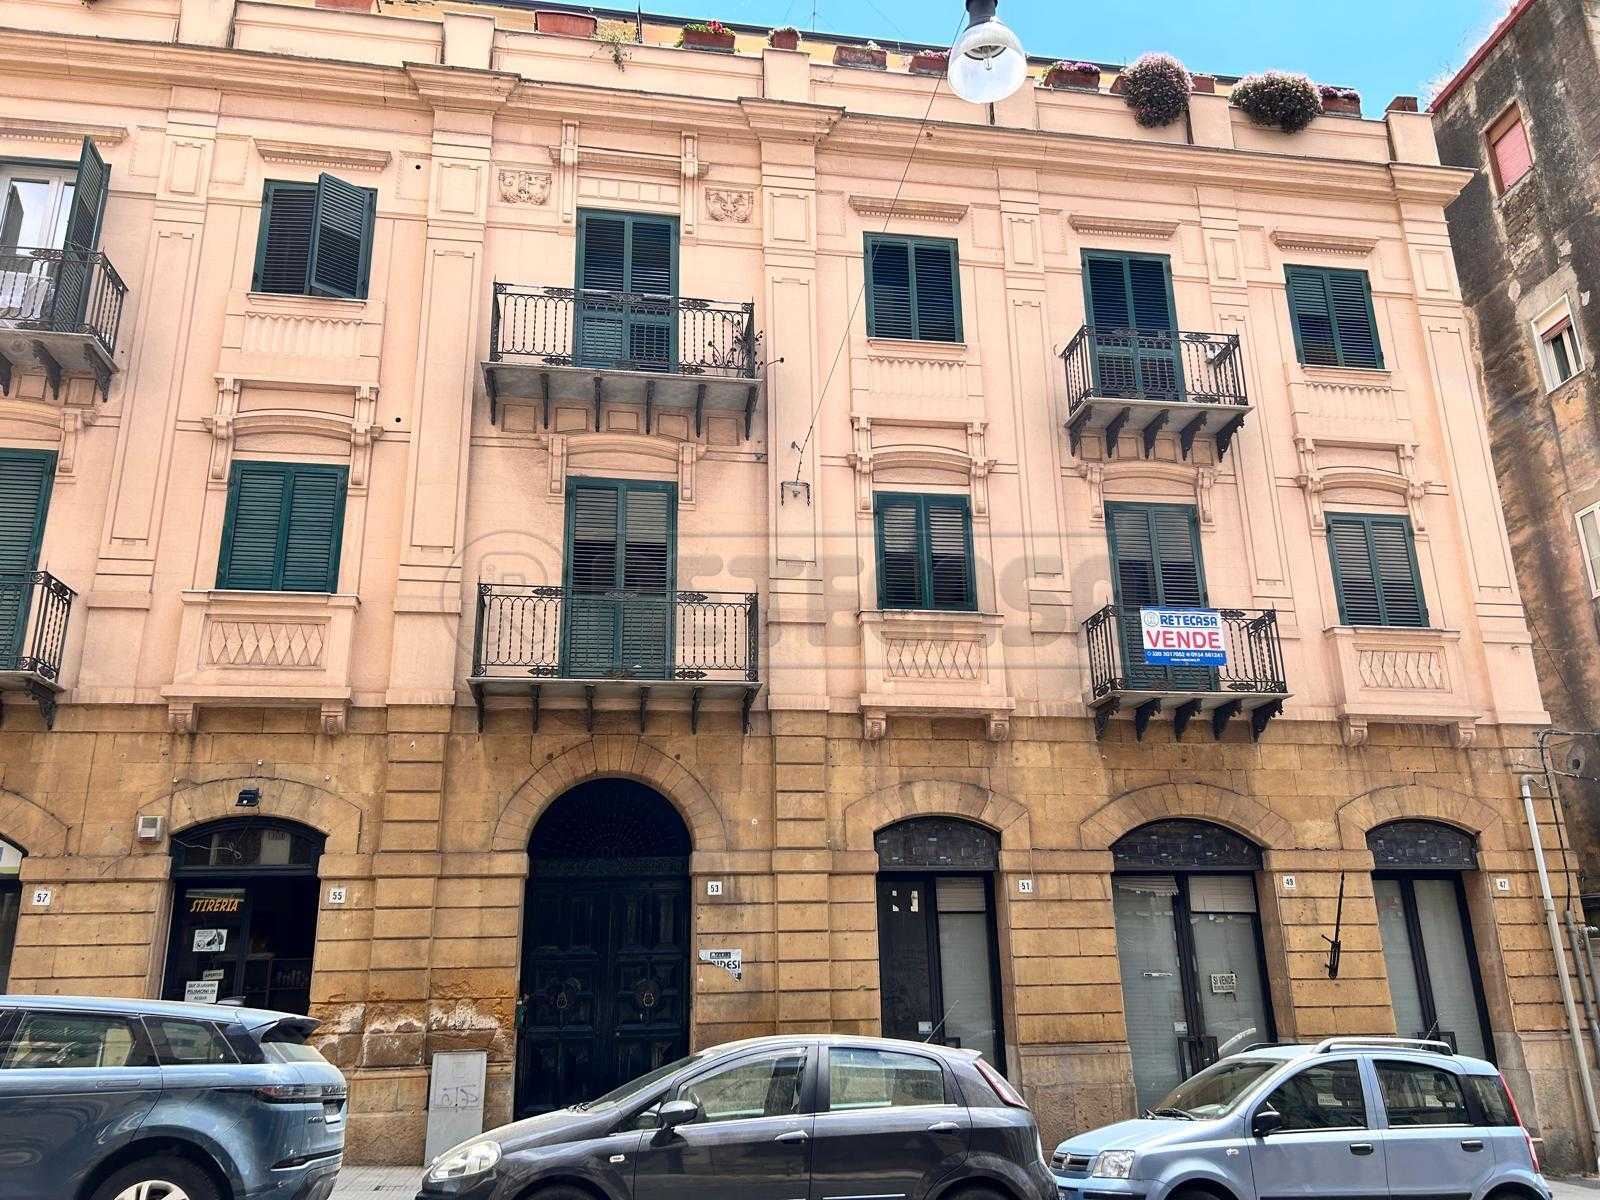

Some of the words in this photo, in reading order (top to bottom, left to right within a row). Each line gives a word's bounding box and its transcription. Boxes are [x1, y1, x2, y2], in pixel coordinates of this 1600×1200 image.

[1160, 615, 1218, 626] RETECASA
[1146, 630, 1220, 649] VENDE
[710, 884, 719, 893] 53
[1021, 882, 1030, 890] 51
[36, 893, 48, 903] 57
[332, 891, 343, 900] 55
[190, 898, 239, 912] STIRERIA
[1219, 975, 1235, 985] VENDE
